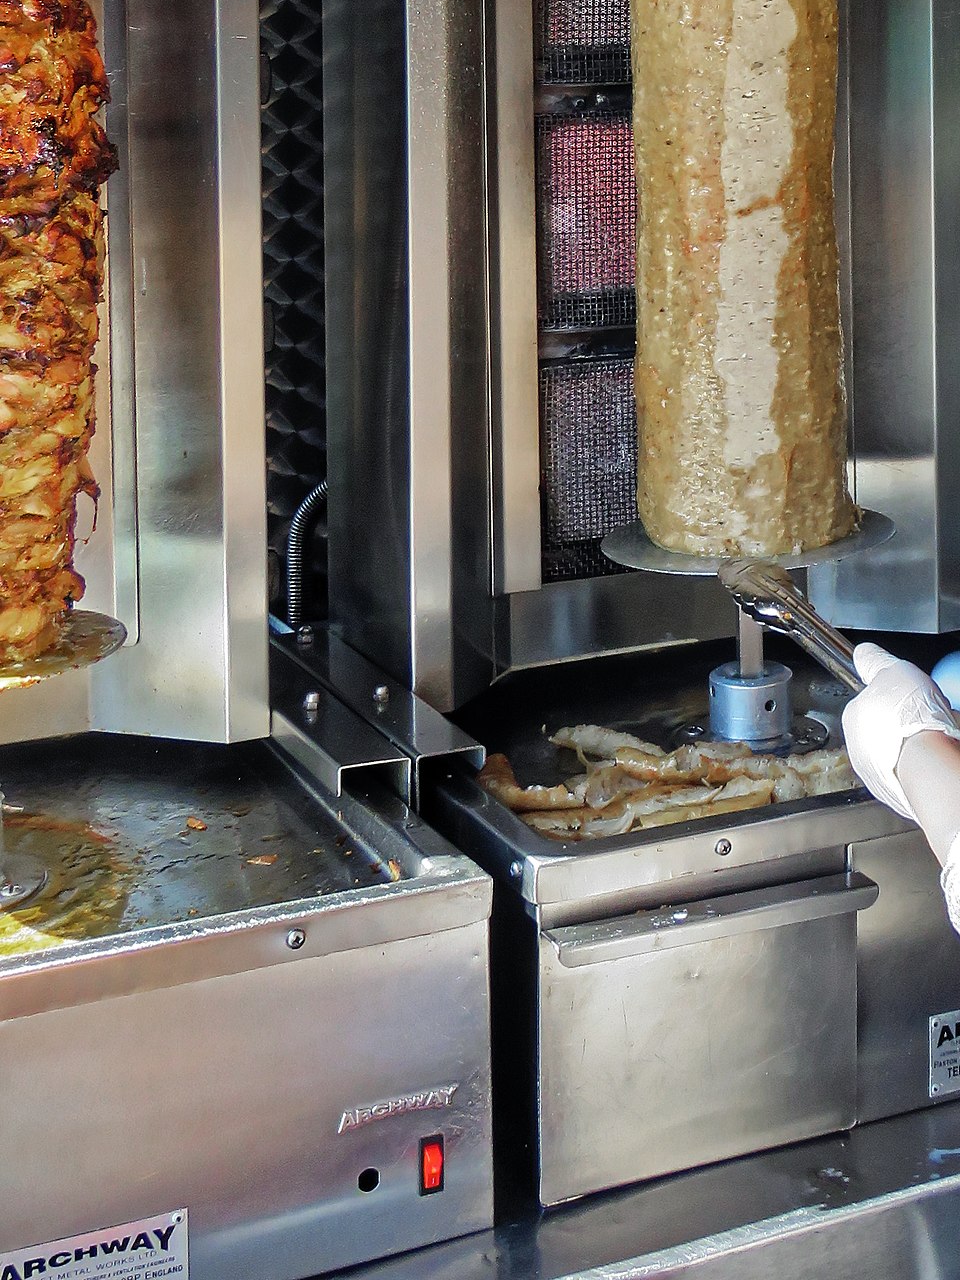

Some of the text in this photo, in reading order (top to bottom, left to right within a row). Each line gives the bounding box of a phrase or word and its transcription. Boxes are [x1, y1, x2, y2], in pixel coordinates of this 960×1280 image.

[337, 1083, 458, 1137] ARCHWAY
[0, 1224, 176, 1280] ARCHWAY
[57, 1266, 91, 1280] METAL
[95, 1256, 135, 1271] WORKS
[138, 1250, 157, 1262] LTD
[144, 1264, 183, 1280] ENGLAND
